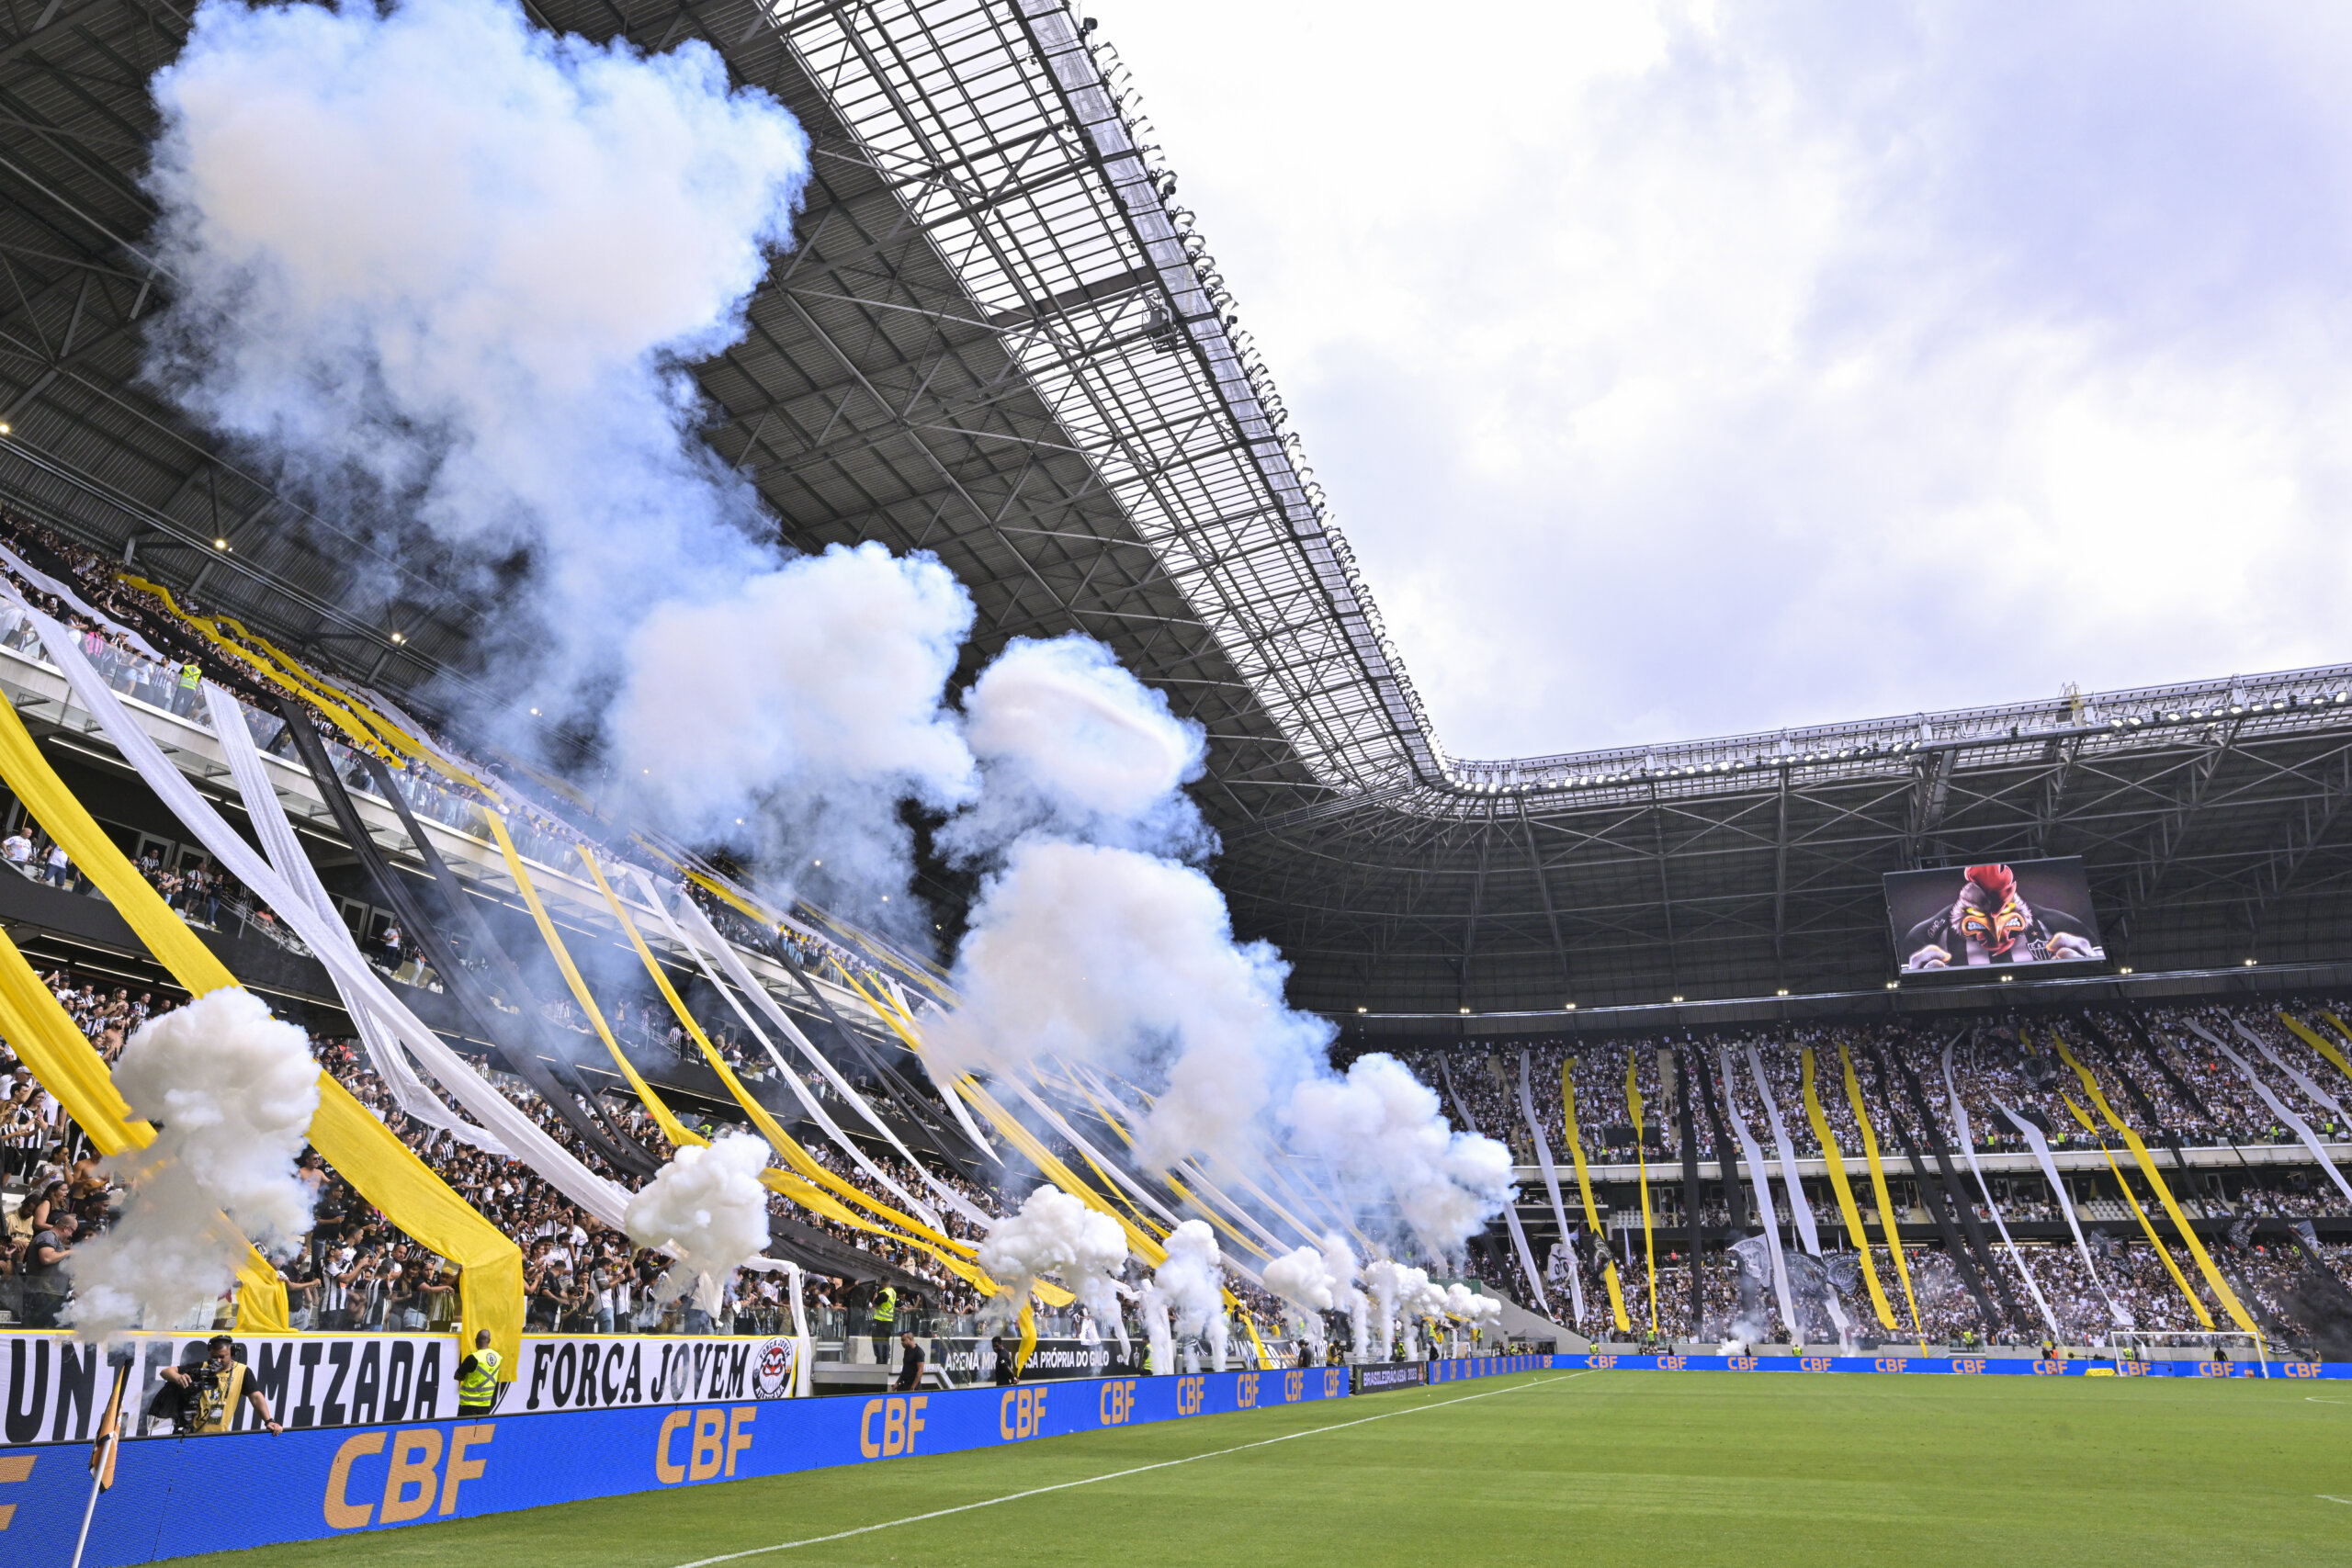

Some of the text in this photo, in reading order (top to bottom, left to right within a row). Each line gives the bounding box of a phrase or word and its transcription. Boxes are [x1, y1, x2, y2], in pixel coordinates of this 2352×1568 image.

[944, 1351, 979, 1371] ARENA
[981, 1351, 999, 1370] MR
[1014, 1351, 1038, 1369] CSA
[1040, 1347, 1075, 1369] PRÓPRIA
[1076, 1350, 1089, 1368] DO
[1090, 1350, 1110, 1367] GALO
[1589, 1355, 1618, 1369] CBF
[1657, 1356, 1687, 1370] CBF
[1727, 1357, 1758, 1371] CBF
[1800, 1358, 1832, 1371] CBF
[1874, 1359, 1907, 1372] CBF
[1952, 1359, 1986, 1373] CBF
[2032, 1360, 2068, 1375] CBF
[2199, 1362, 2234, 1377] CBF
[2284, 1362, 2322, 1378] CBF
[1284, 1371, 1304, 1402] CBF
[1324, 1369, 1340, 1397] CBF
[1363, 1366, 1397, 1387] BRASILEIRÃO
[5, 1338, 441, 1444] UNIFMIZADA
[650, 1342, 751, 1403] JOVEM
[1177, 1376, 1204, 1416] CBF
[1237, 1373, 1260, 1407] CBF
[1001, 1387, 1048, 1440] CBF
[1100, 1381, 1136, 1426] CBF
[861, 1395, 928, 1459] CBF
[657, 1405, 758, 1484] CBF
[324, 1424, 496, 1530] CBF
